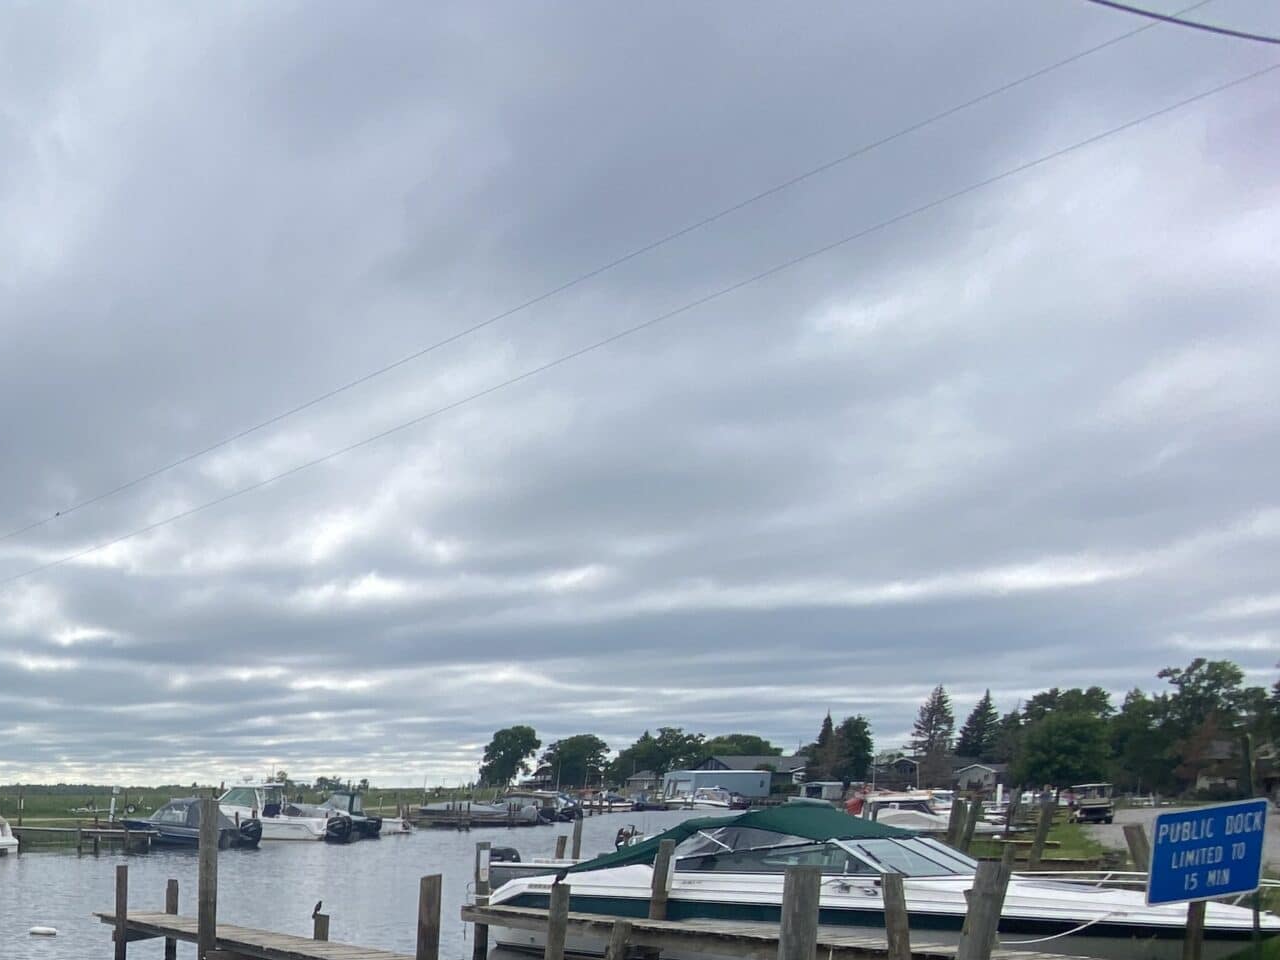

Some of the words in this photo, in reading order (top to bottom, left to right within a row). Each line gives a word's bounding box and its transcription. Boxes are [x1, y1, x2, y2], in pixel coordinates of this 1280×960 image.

[1158, 817, 1215, 844] PUBLIC
[1225, 811, 1263, 836] DOCK
[1171, 846, 1223, 869] LIMITED
[1232, 842, 1246, 860] TO
[1184, 873, 1199, 890] 15
[1206, 868, 1231, 887] MIN
